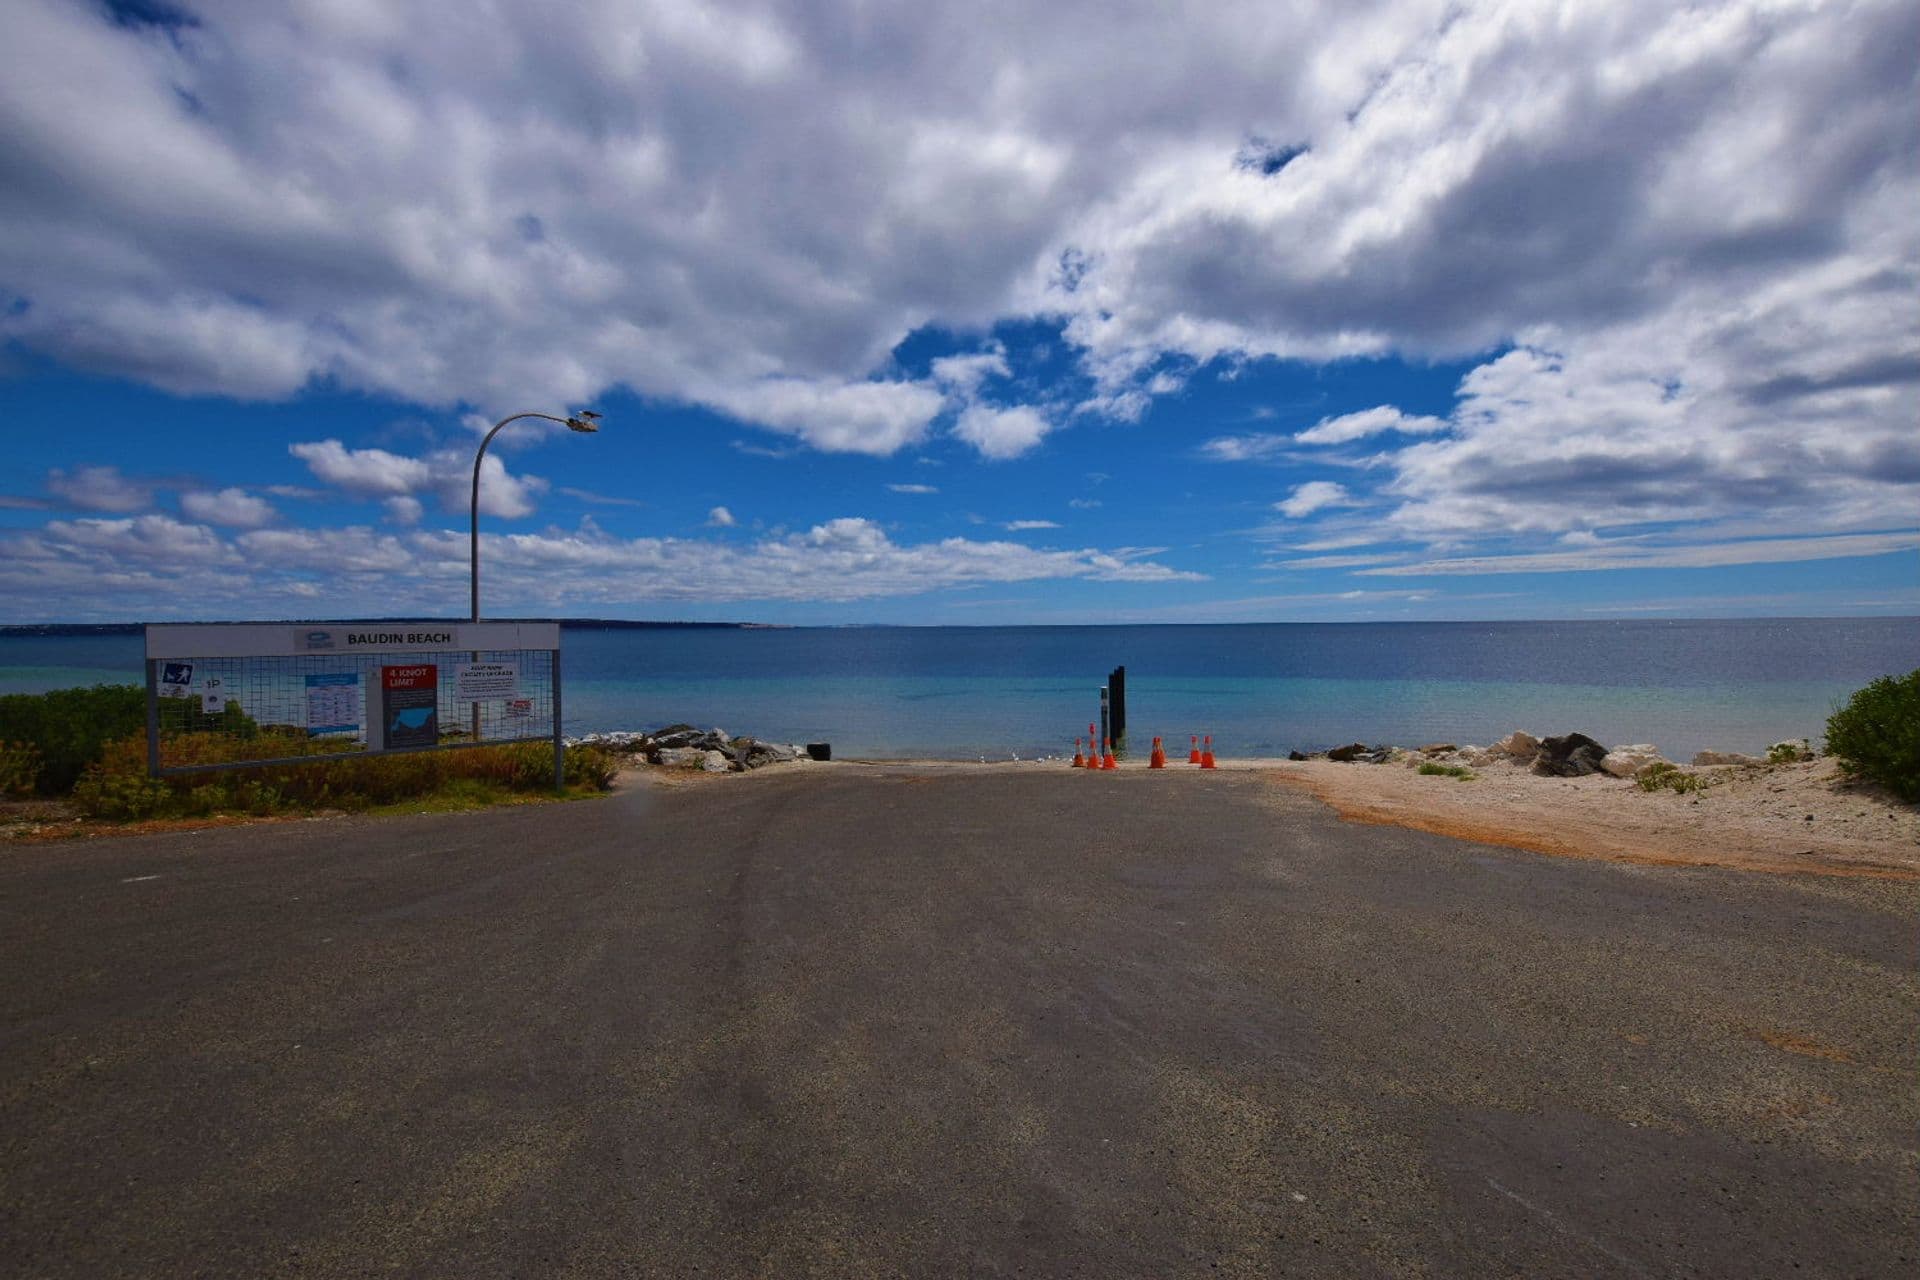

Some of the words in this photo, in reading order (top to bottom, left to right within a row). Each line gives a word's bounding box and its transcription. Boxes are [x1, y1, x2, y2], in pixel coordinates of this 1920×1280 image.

[348, 633, 403, 645] BAUDIN
[407, 633, 451, 644] BEACH
[399, 668, 427, 677] KNOT
[390, 678, 415, 687] LIMIT
